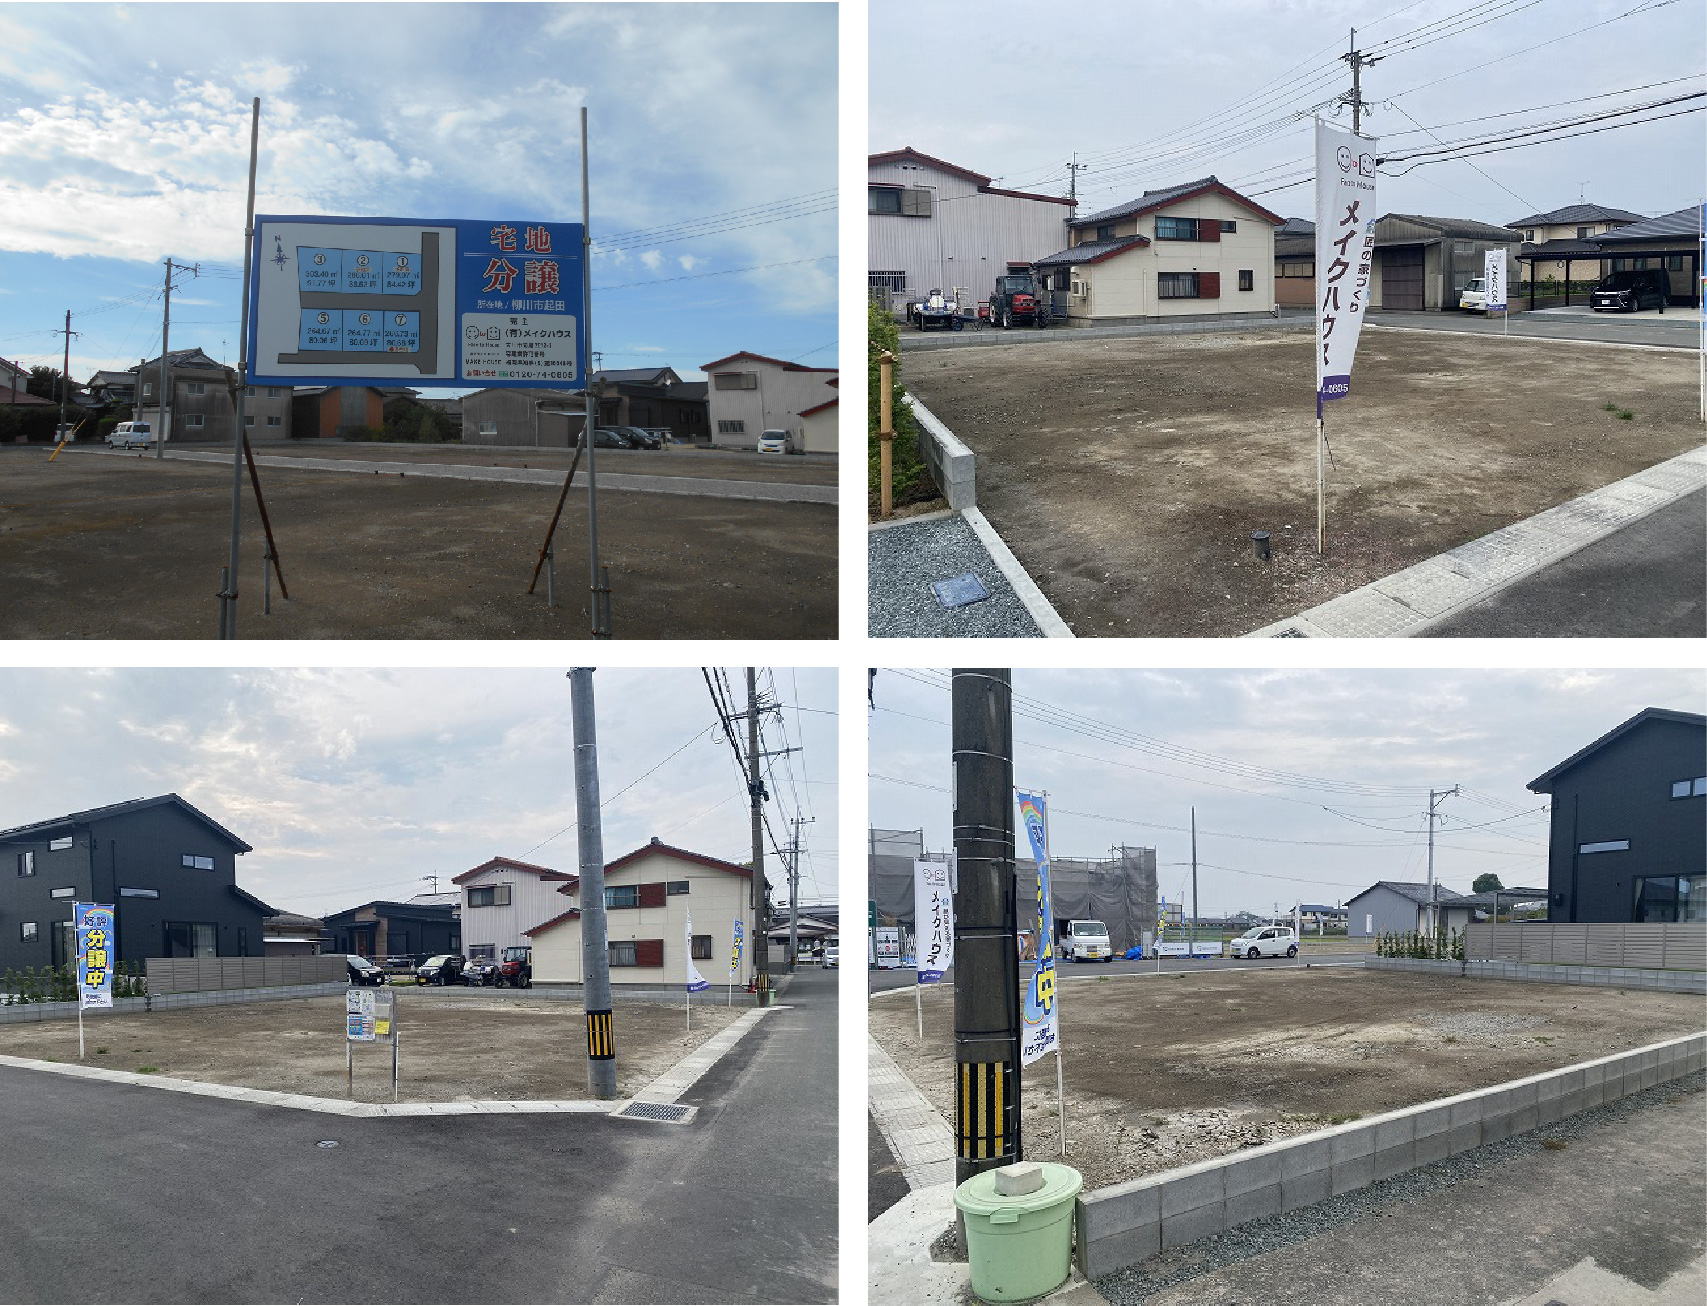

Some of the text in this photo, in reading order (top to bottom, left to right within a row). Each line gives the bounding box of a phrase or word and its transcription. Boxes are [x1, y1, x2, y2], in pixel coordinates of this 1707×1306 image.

[490, 225, 551, 253] 宅地
[482, 257, 560, 295] 分譲
[369, 280, 377, 288] 坪
[407, 281, 416, 289] 坪
[329, 337, 338, 345] 坪
[370, 338, 378, 347] 坪
[408, 339, 416, 348] 坪
[509, 370, 573, 379] 0120-74-0605
[927, 890, 942, 966] メイクハウス
[86, 929, 107, 989] 分譲中
